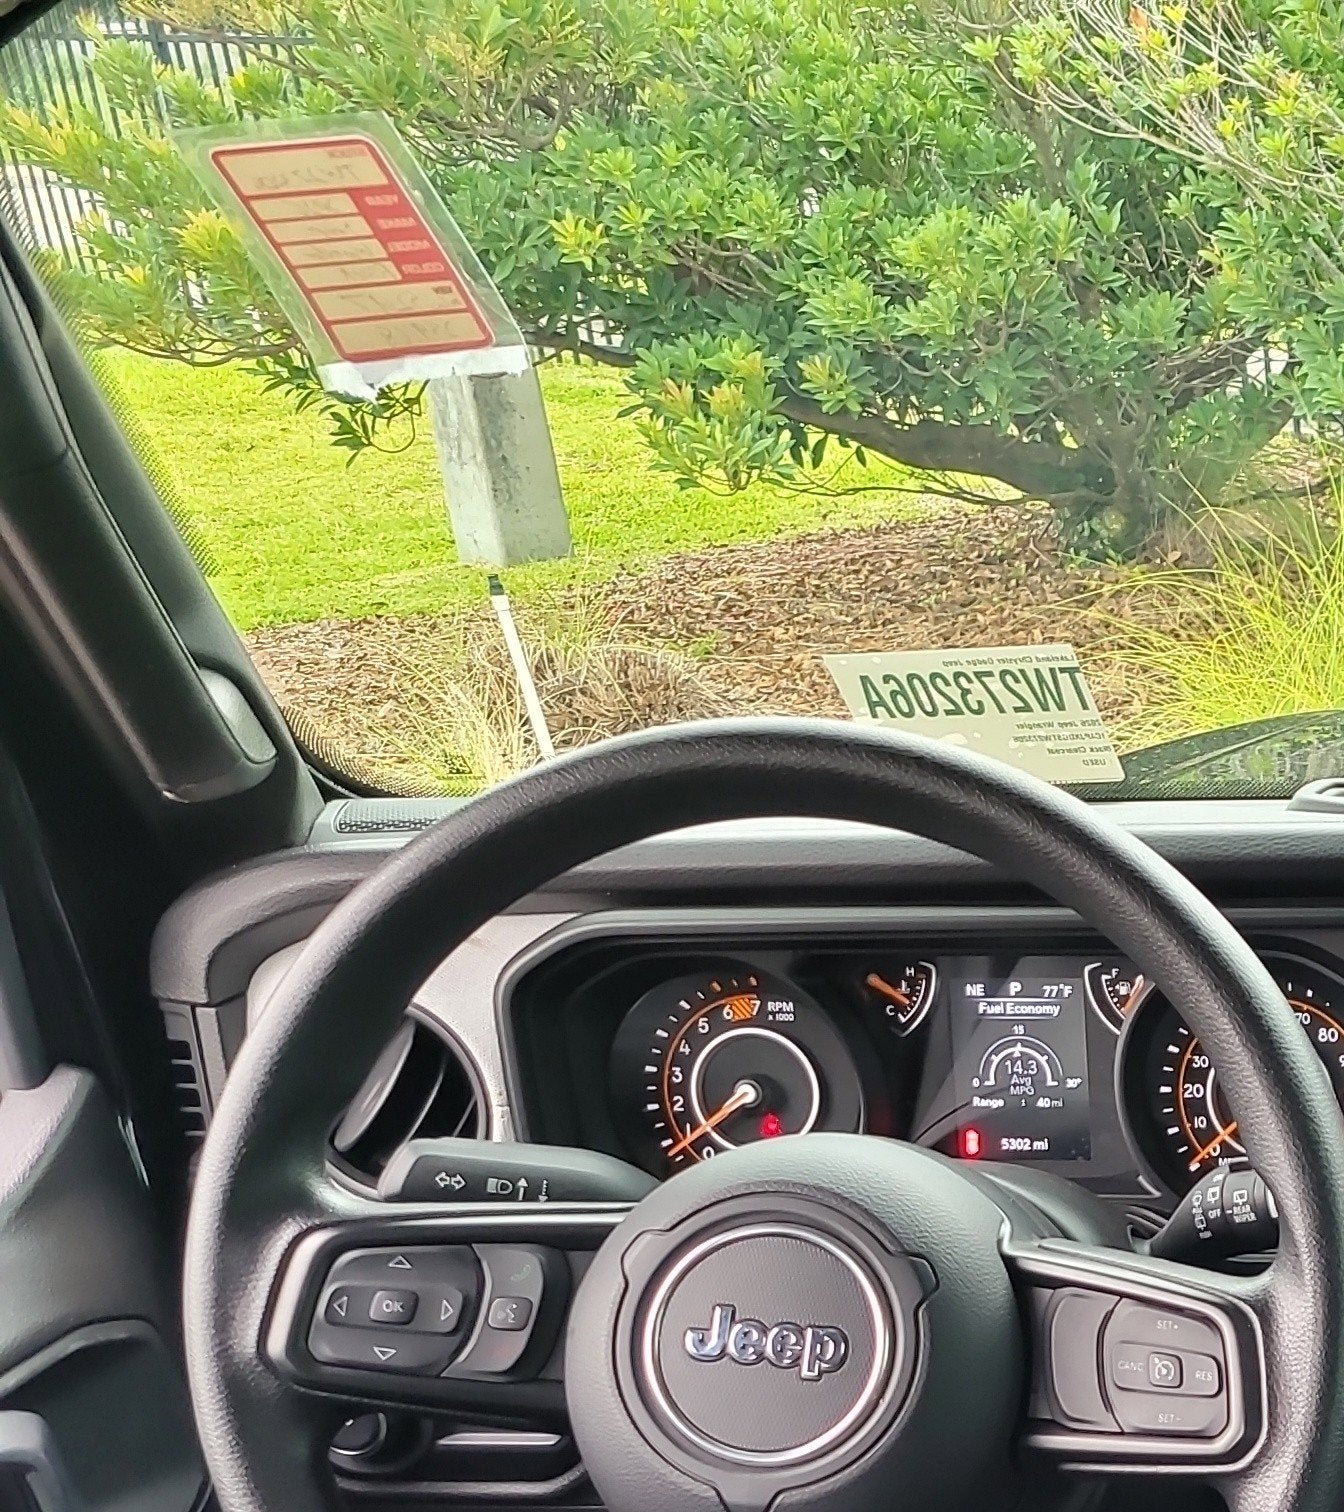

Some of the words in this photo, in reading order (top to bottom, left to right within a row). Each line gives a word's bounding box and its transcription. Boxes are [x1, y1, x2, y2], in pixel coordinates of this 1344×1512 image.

[906, 967, 915, 976] H
[966, 984, 985, 996] NE
[1010, 982, 1022, 996] P
[723, 1005, 734, 1020] 6
[750, 1000, 761, 1016] 7
[767, 1001, 795, 1012] RPM
[886, 1005, 895, 1015] C
[979, 1003, 1004, 1015] Fuel
[1006, 1004, 1061, 1016] Economy
[775, 1013, 795, 1021] 1000
[698, 1018, 710, 1034] 5
[1013, 1024, 1025, 1035] 15
[1318, 1029, 1339, 1043] 80
[679, 1039, 691, 1055] 4
[1005, 1060, 1038, 1075] 14.3
[1193, 1056, 1209, 1068] 30
[671, 1067, 683, 1083] 3
[1011, 1076, 1032, 1087] Avg
[1010, 1086, 1034, 1096] MPG
[1183, 1084, 1205, 1098] 20
[673, 1096, 685, 1111] 2
[972, 1098, 1005, 1108] Range
[1036, 1098, 1051, 1107] 40
[1051, 1098, 1063, 1107] mi
[1194, 1117, 1207, 1129] 10
[1001, 1138, 1032, 1150] 5302
[1033, 1138, 1049, 1150] mi
[702, 1146, 715, 1160] 0
[383, 1299, 404, 1313] OK
[684, 1303, 850, 1381] Jeep
[1195, 1370, 1214, 1381] RES
